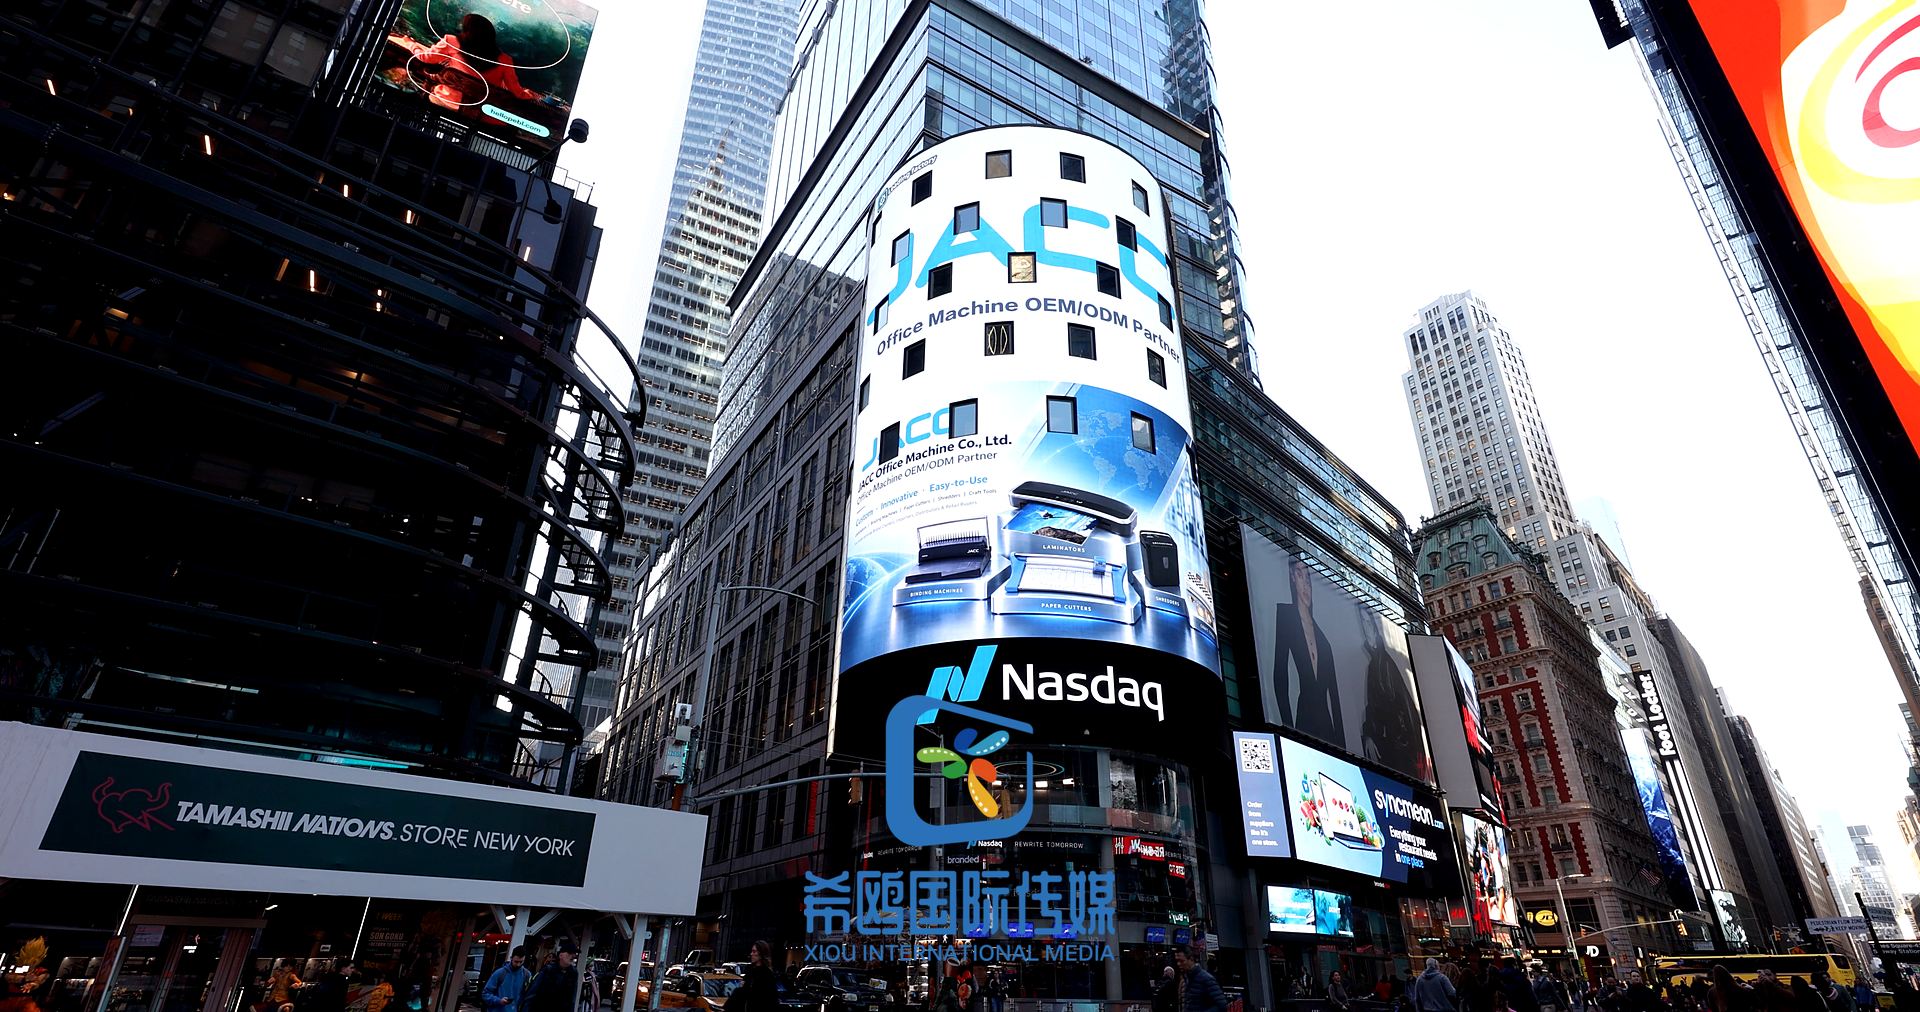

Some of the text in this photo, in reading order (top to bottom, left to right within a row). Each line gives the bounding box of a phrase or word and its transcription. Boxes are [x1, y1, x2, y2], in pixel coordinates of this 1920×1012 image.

[877, 297, 1181, 364] Office Machine OEM/ODM Partner
[862, 407, 950, 472] JCC
[858, 434, 1012, 493] JACC Office Machine Co., Ltd.
[872, 473, 903, 493] Machine
[904, 456, 954, 478] OEM/ODM
[957, 452, 998, 464] Partner
[880, 490, 919, 510] Innovative
[929, 476, 988, 493] Easy-to-Use
[1042, 544, 1085, 553] LAMINATORS
[934, 587, 963, 595] MACHINES
[1041, 602, 1092, 612] PAPER CUTTERS
[1002, 663, 1165, 722] Nasdaq
[1652, 723, 1677, 756] Foot
[1374, 789, 1445, 830] syncmeon.com
[176, 801, 576, 857] TAMASHII NATIONS STORE NEW YORK
[977, 840, 1003, 848] Nasdaq
[1388, 825, 1416, 847] Everything
[947, 855, 979, 864] branded
[1585, 945, 1600, 958] JD
